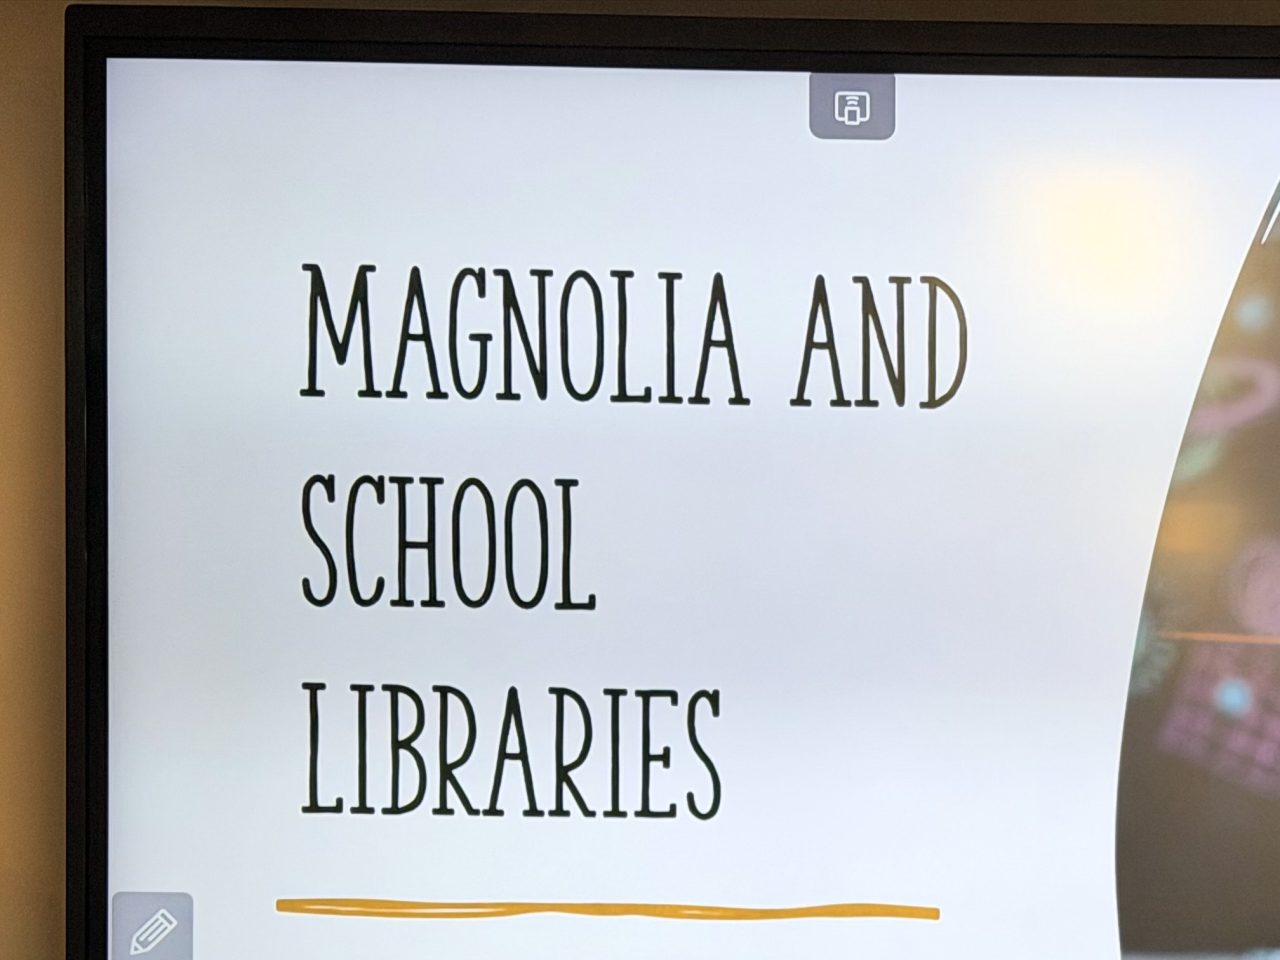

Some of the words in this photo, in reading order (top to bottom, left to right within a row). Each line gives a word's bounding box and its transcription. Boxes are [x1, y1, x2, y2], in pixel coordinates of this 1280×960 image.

[300, 263, 751, 407] MAGNOLIA
[789, 274, 969, 410] AND
[300, 474, 597, 611] SCHOOL
[300, 682, 722, 821] LIBRARIES
